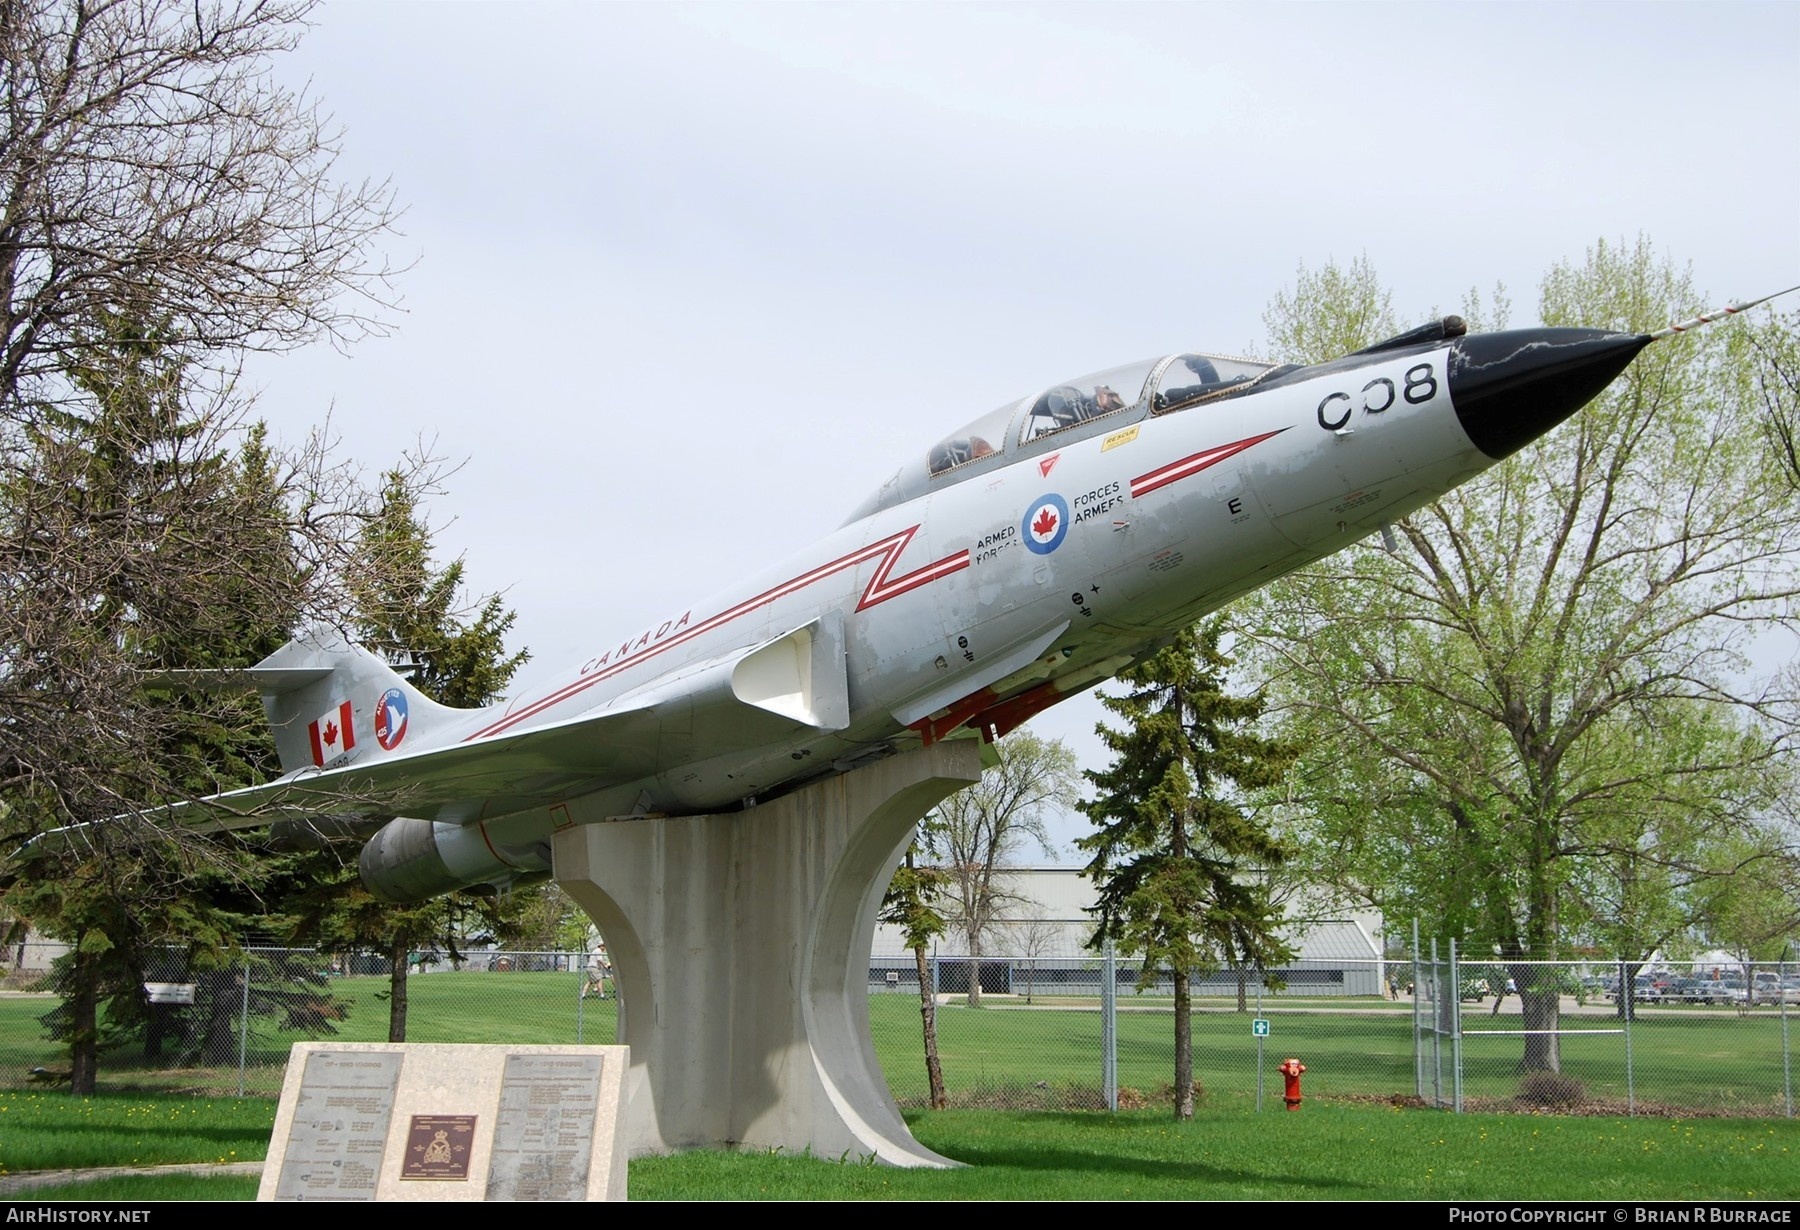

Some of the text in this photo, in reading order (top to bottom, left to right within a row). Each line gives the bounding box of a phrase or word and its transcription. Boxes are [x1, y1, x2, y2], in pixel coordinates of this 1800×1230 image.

[1106, 428, 1137, 444] RESCUE
[1074, 481, 1120, 508] FORCES
[977, 526, 1016, 549] ARMED
[580, 610, 691, 675] CANADA
